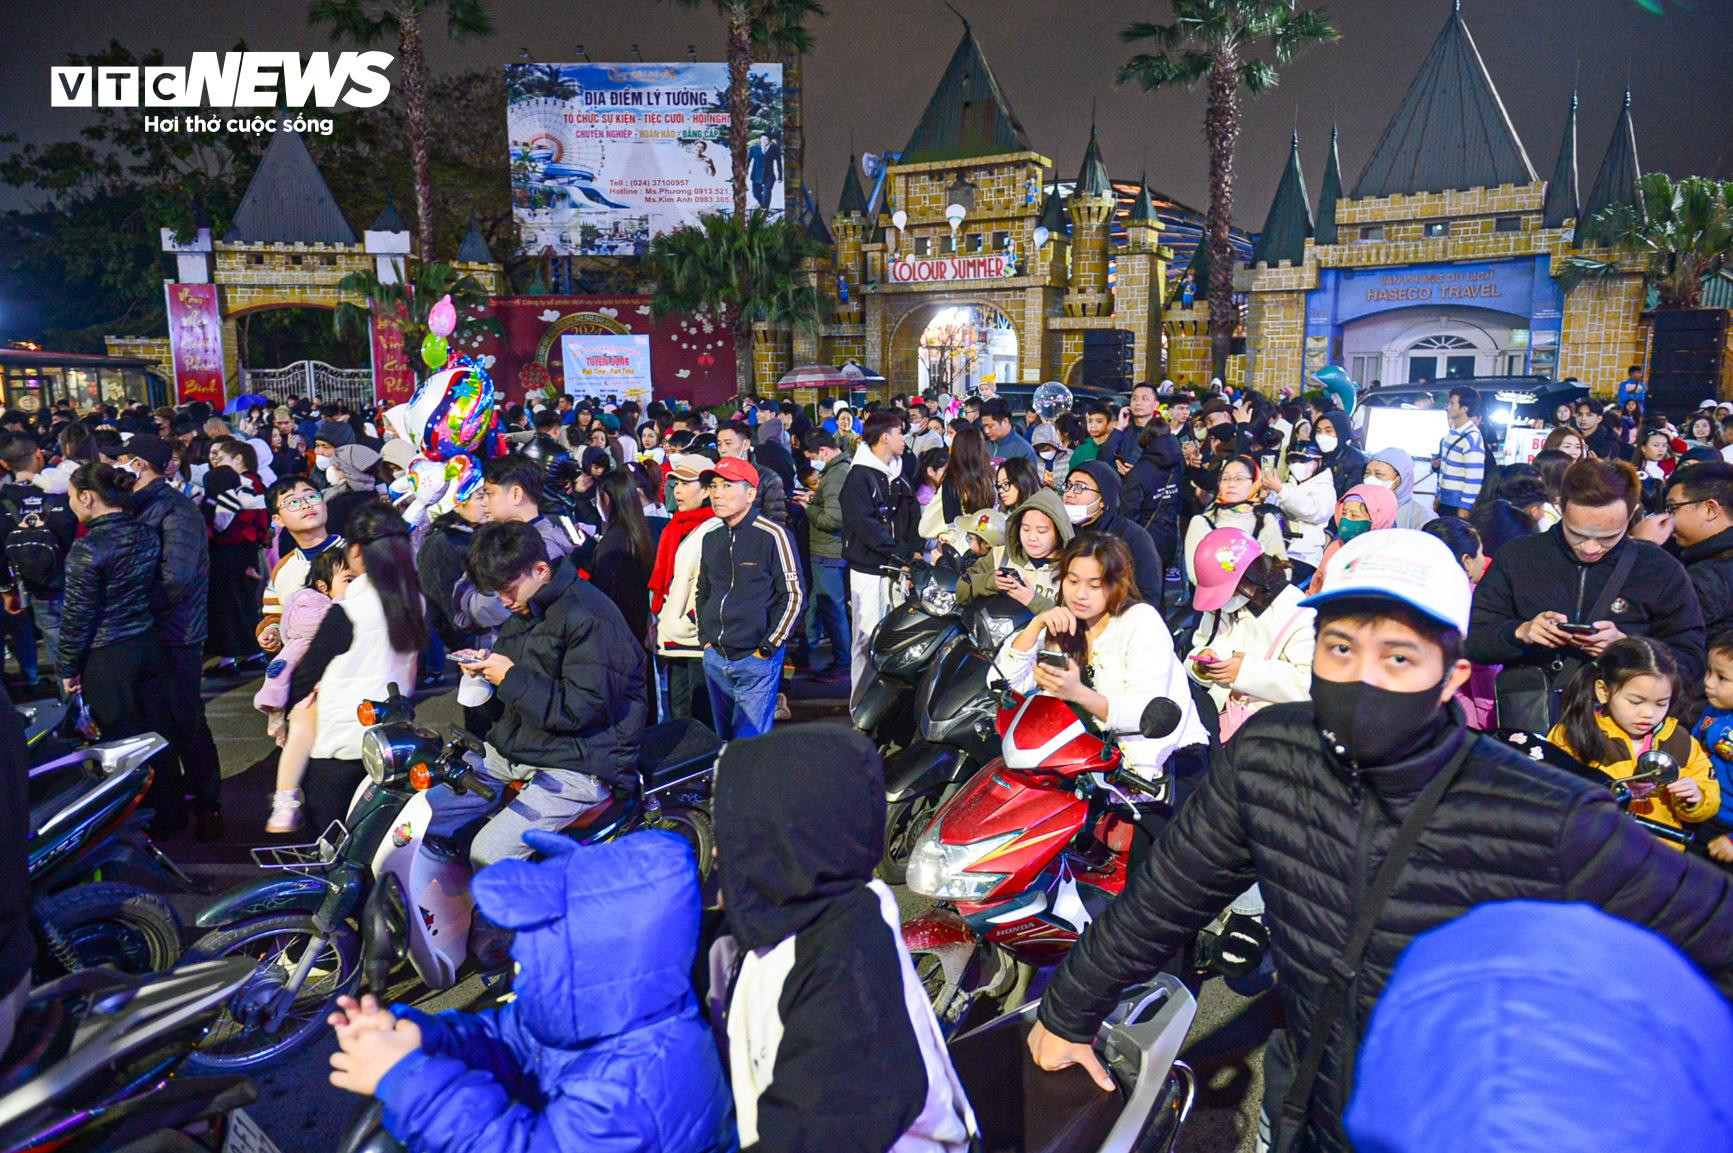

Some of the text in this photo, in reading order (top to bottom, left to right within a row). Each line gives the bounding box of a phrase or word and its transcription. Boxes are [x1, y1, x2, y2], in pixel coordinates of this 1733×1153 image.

[585, 86, 708, 109] ĐỊA ĐIỂM LÝ TƯỞNG
[616, 112, 636, 126] KIỆN
[644, 112, 662, 125] TIỆC
[665, 112, 685, 124] CƯỚI
[576, 128, 604, 138] CHUYÊN
[606, 128, 632, 139] NGHIỆP
[630, 179, 650, 188] (024)
[893, 255, 1003, 282] COLOUR SUMMER
[1367, 284, 1501, 301] HASECO TRAVEL
[996, 922, 1036, 937] HONDA
